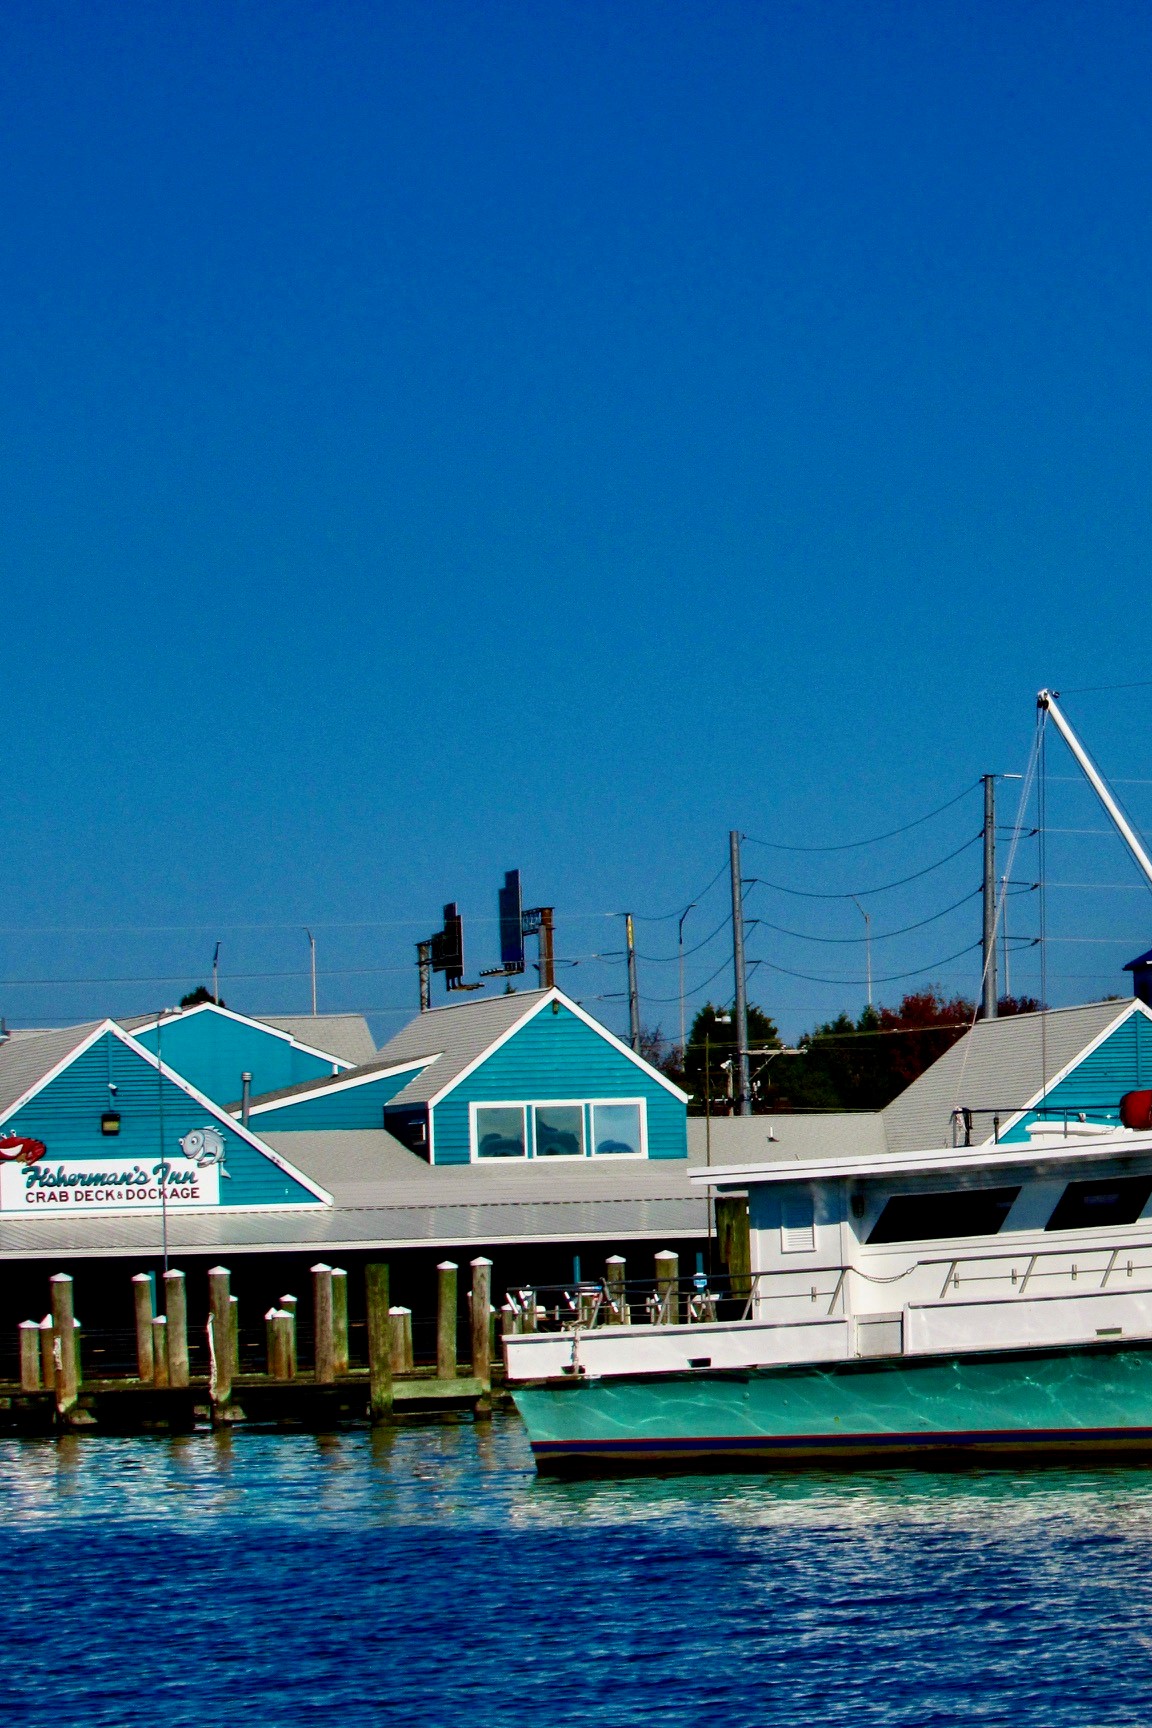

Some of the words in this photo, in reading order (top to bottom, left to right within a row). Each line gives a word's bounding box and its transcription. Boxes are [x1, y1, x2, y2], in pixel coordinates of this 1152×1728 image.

[21, 1164, 151, 1189] Fisherman's
[152, 1162, 198, 1185] Inn
[25, 1190, 69, 1204] CRAB
